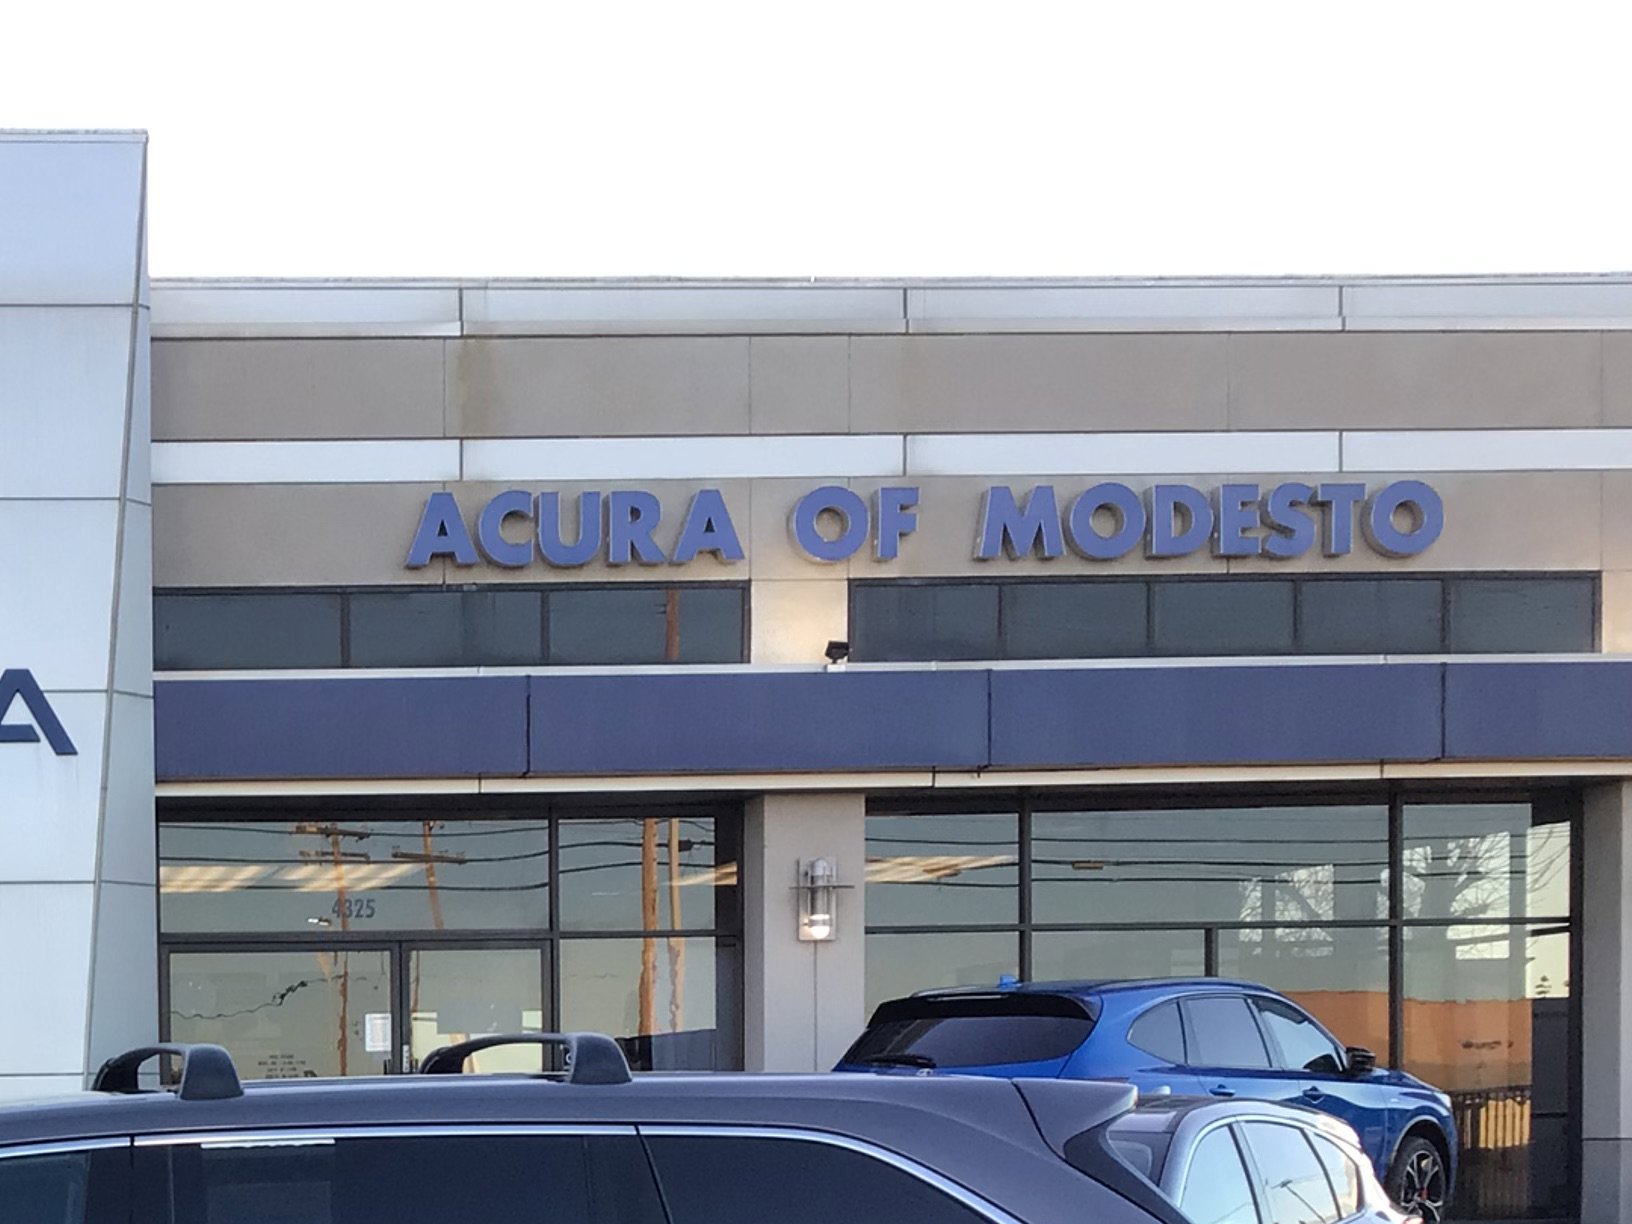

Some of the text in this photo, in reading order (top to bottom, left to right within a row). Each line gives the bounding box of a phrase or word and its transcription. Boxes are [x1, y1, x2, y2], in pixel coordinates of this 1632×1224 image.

[405, 480, 1444, 567] ACURA OF MODESTO
[332, 899, 375, 918] 4325
